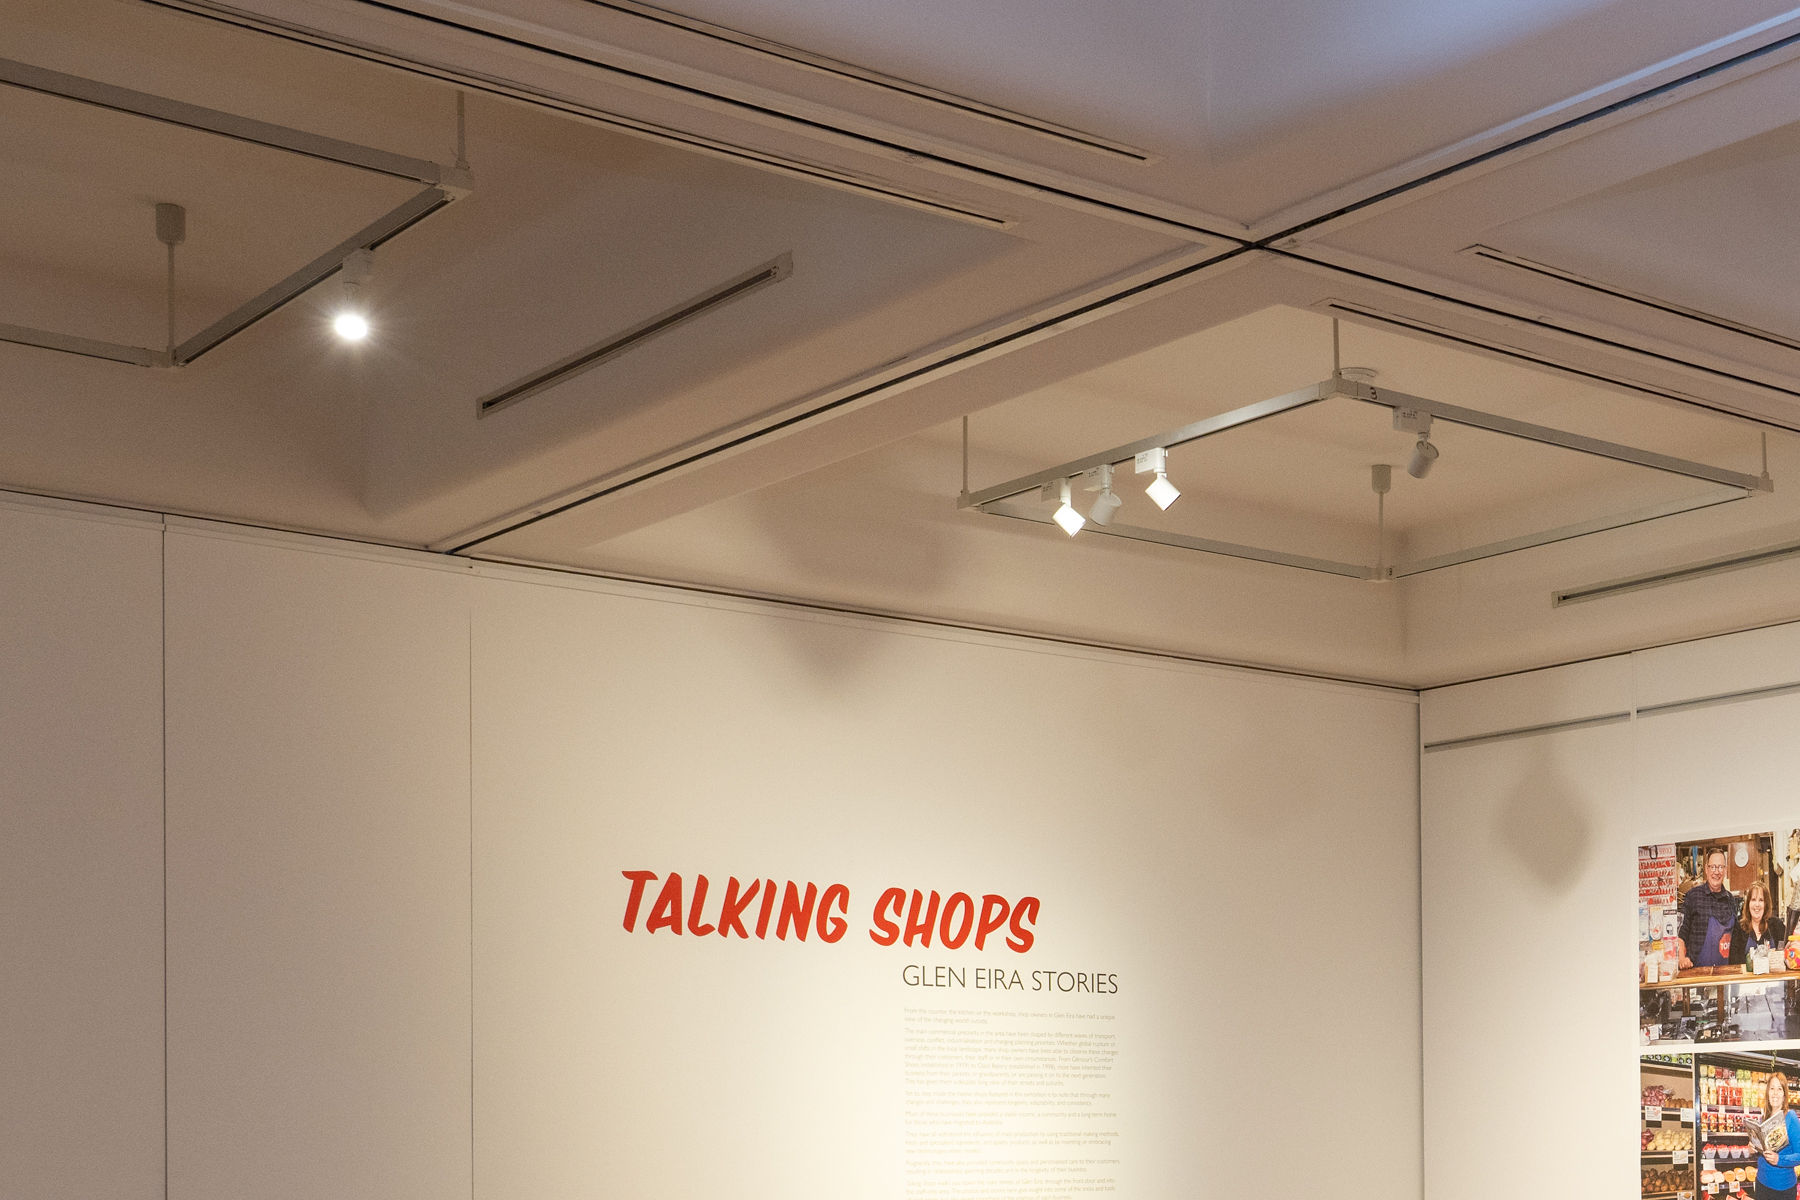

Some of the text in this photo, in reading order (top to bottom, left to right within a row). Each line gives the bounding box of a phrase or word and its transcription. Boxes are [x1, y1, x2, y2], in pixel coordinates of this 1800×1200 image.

[621, 870, 1041, 954] TALKING SHOPS
[902, 964, 1119, 994] GLEN EIRA STORIES
